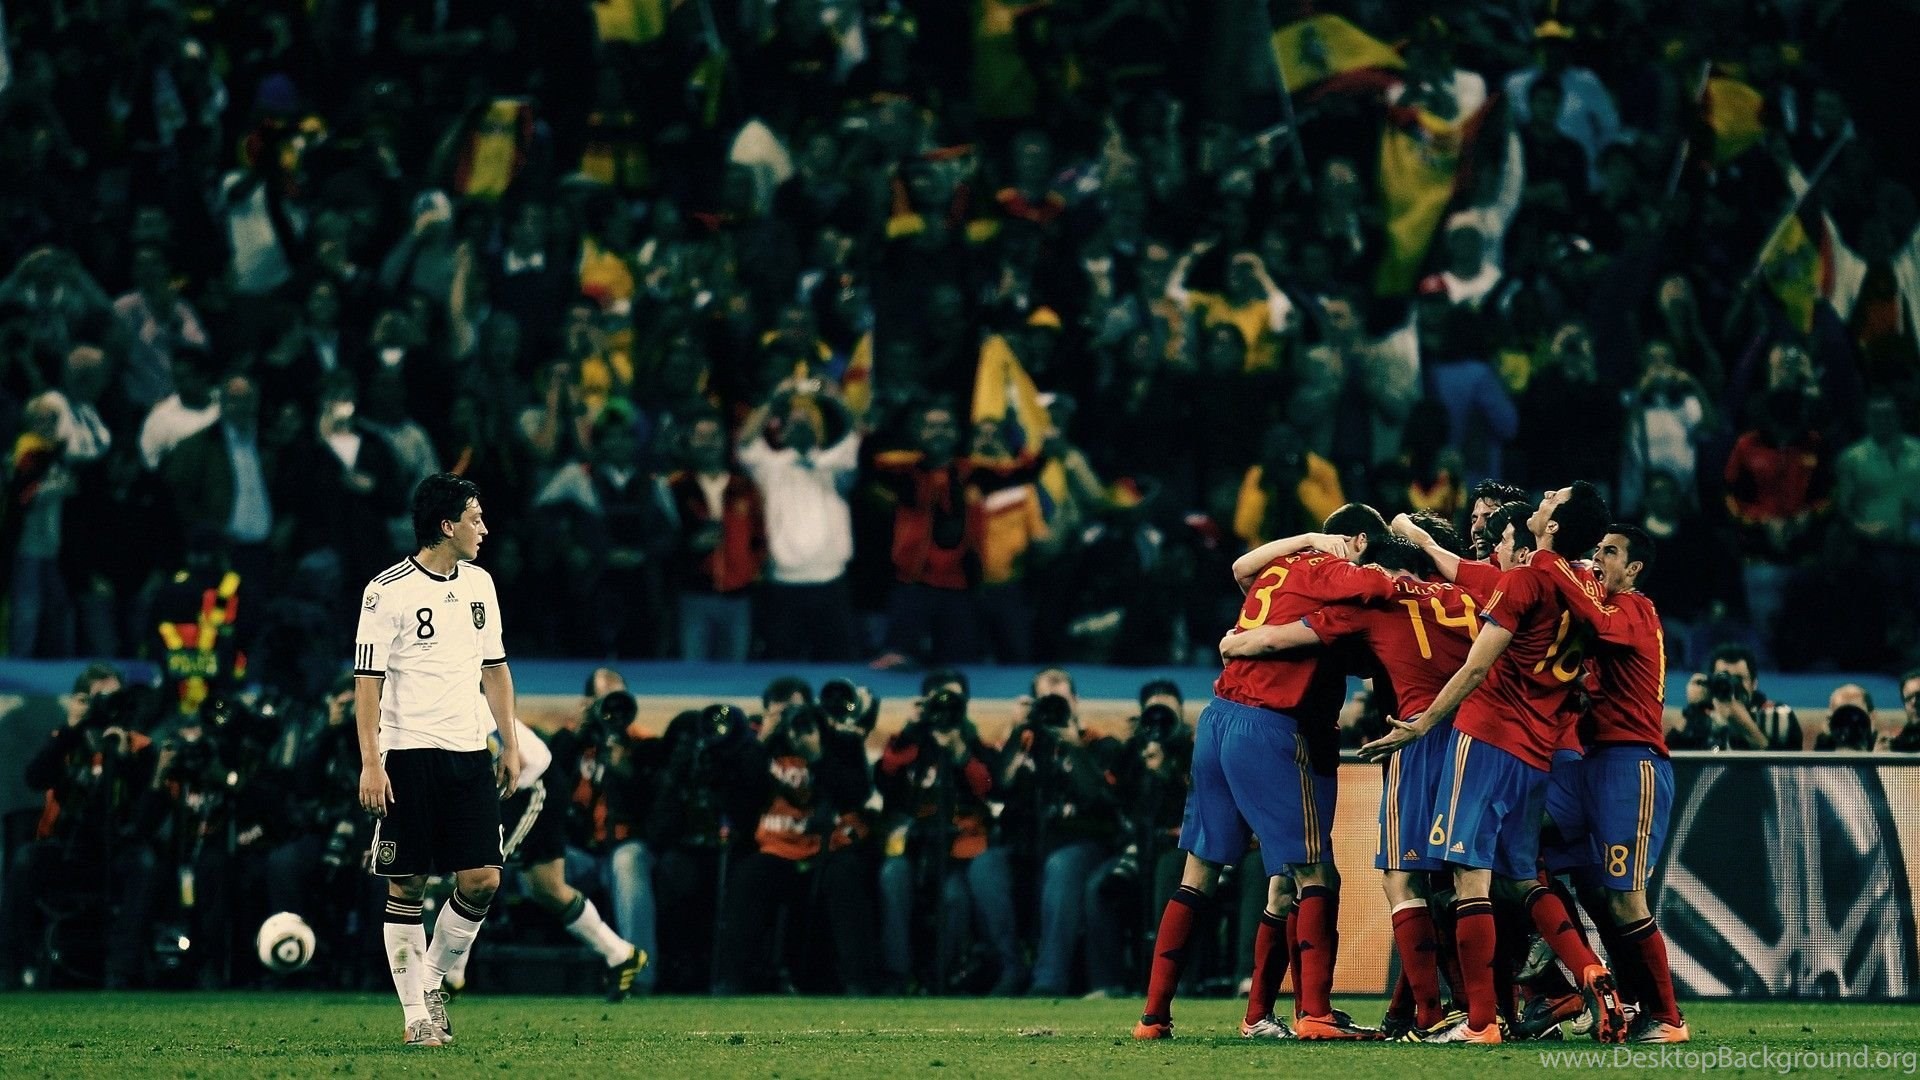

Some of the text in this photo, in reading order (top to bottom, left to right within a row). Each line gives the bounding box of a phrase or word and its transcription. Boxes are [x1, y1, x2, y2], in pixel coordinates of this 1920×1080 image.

[416, 608, 435, 639] 8
[1239, 565, 1290, 630] 3
[1398, 593, 1479, 659] 14
